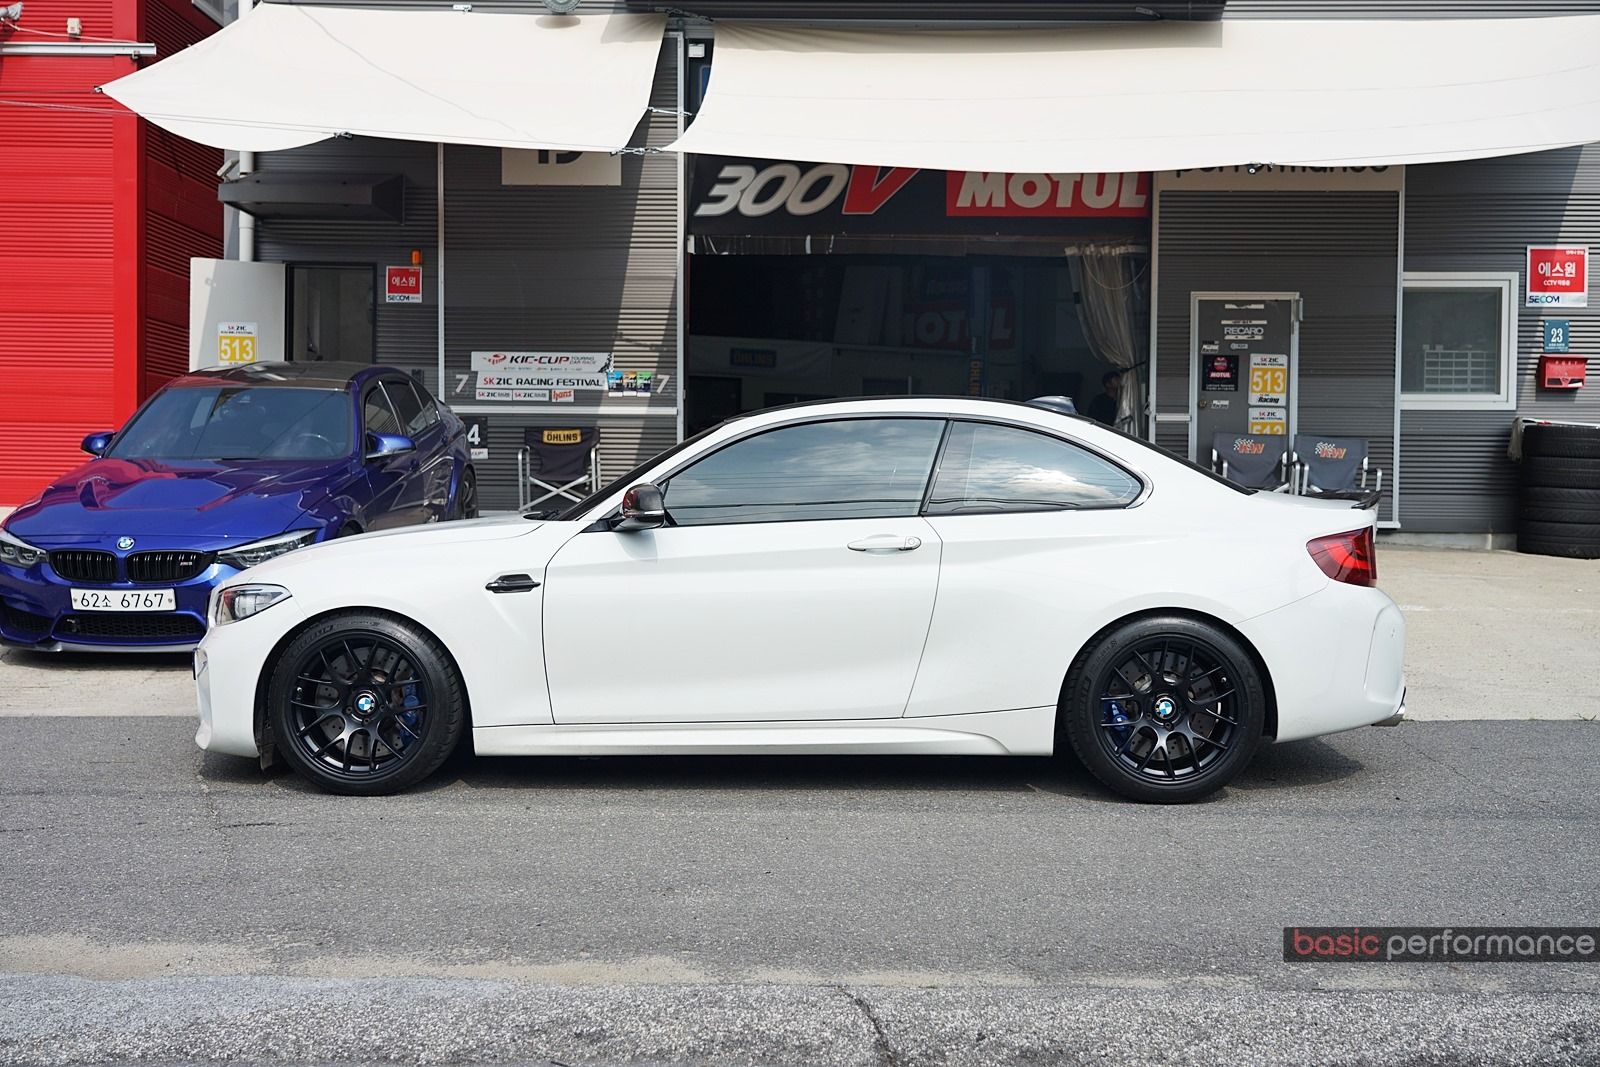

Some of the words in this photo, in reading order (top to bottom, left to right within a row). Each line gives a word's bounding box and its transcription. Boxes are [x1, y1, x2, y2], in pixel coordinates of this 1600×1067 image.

[694, 163, 921, 217] 300V
[956, 171, 1148, 209] MOTUL
[1538, 261, 1576, 278] 에스원
[391, 276, 416, 287] 에스원
[1529, 295, 1560, 304] SECOM
[1224, 327, 1265, 335] RECARO
[1551, 328, 1563, 343] 23
[221, 339, 253, 361] 513
[509, 355, 570, 365] KIC-CUP
[483, 377, 495, 385] SK
[496, 378, 512, 386] ZIC
[516, 378, 554, 386] RACING
[556, 379, 602, 387] FESTIVAL
[1252, 371, 1284, 392] 513
[80, 593, 112, 608] 62소
[120, 593, 164, 609] 6767
